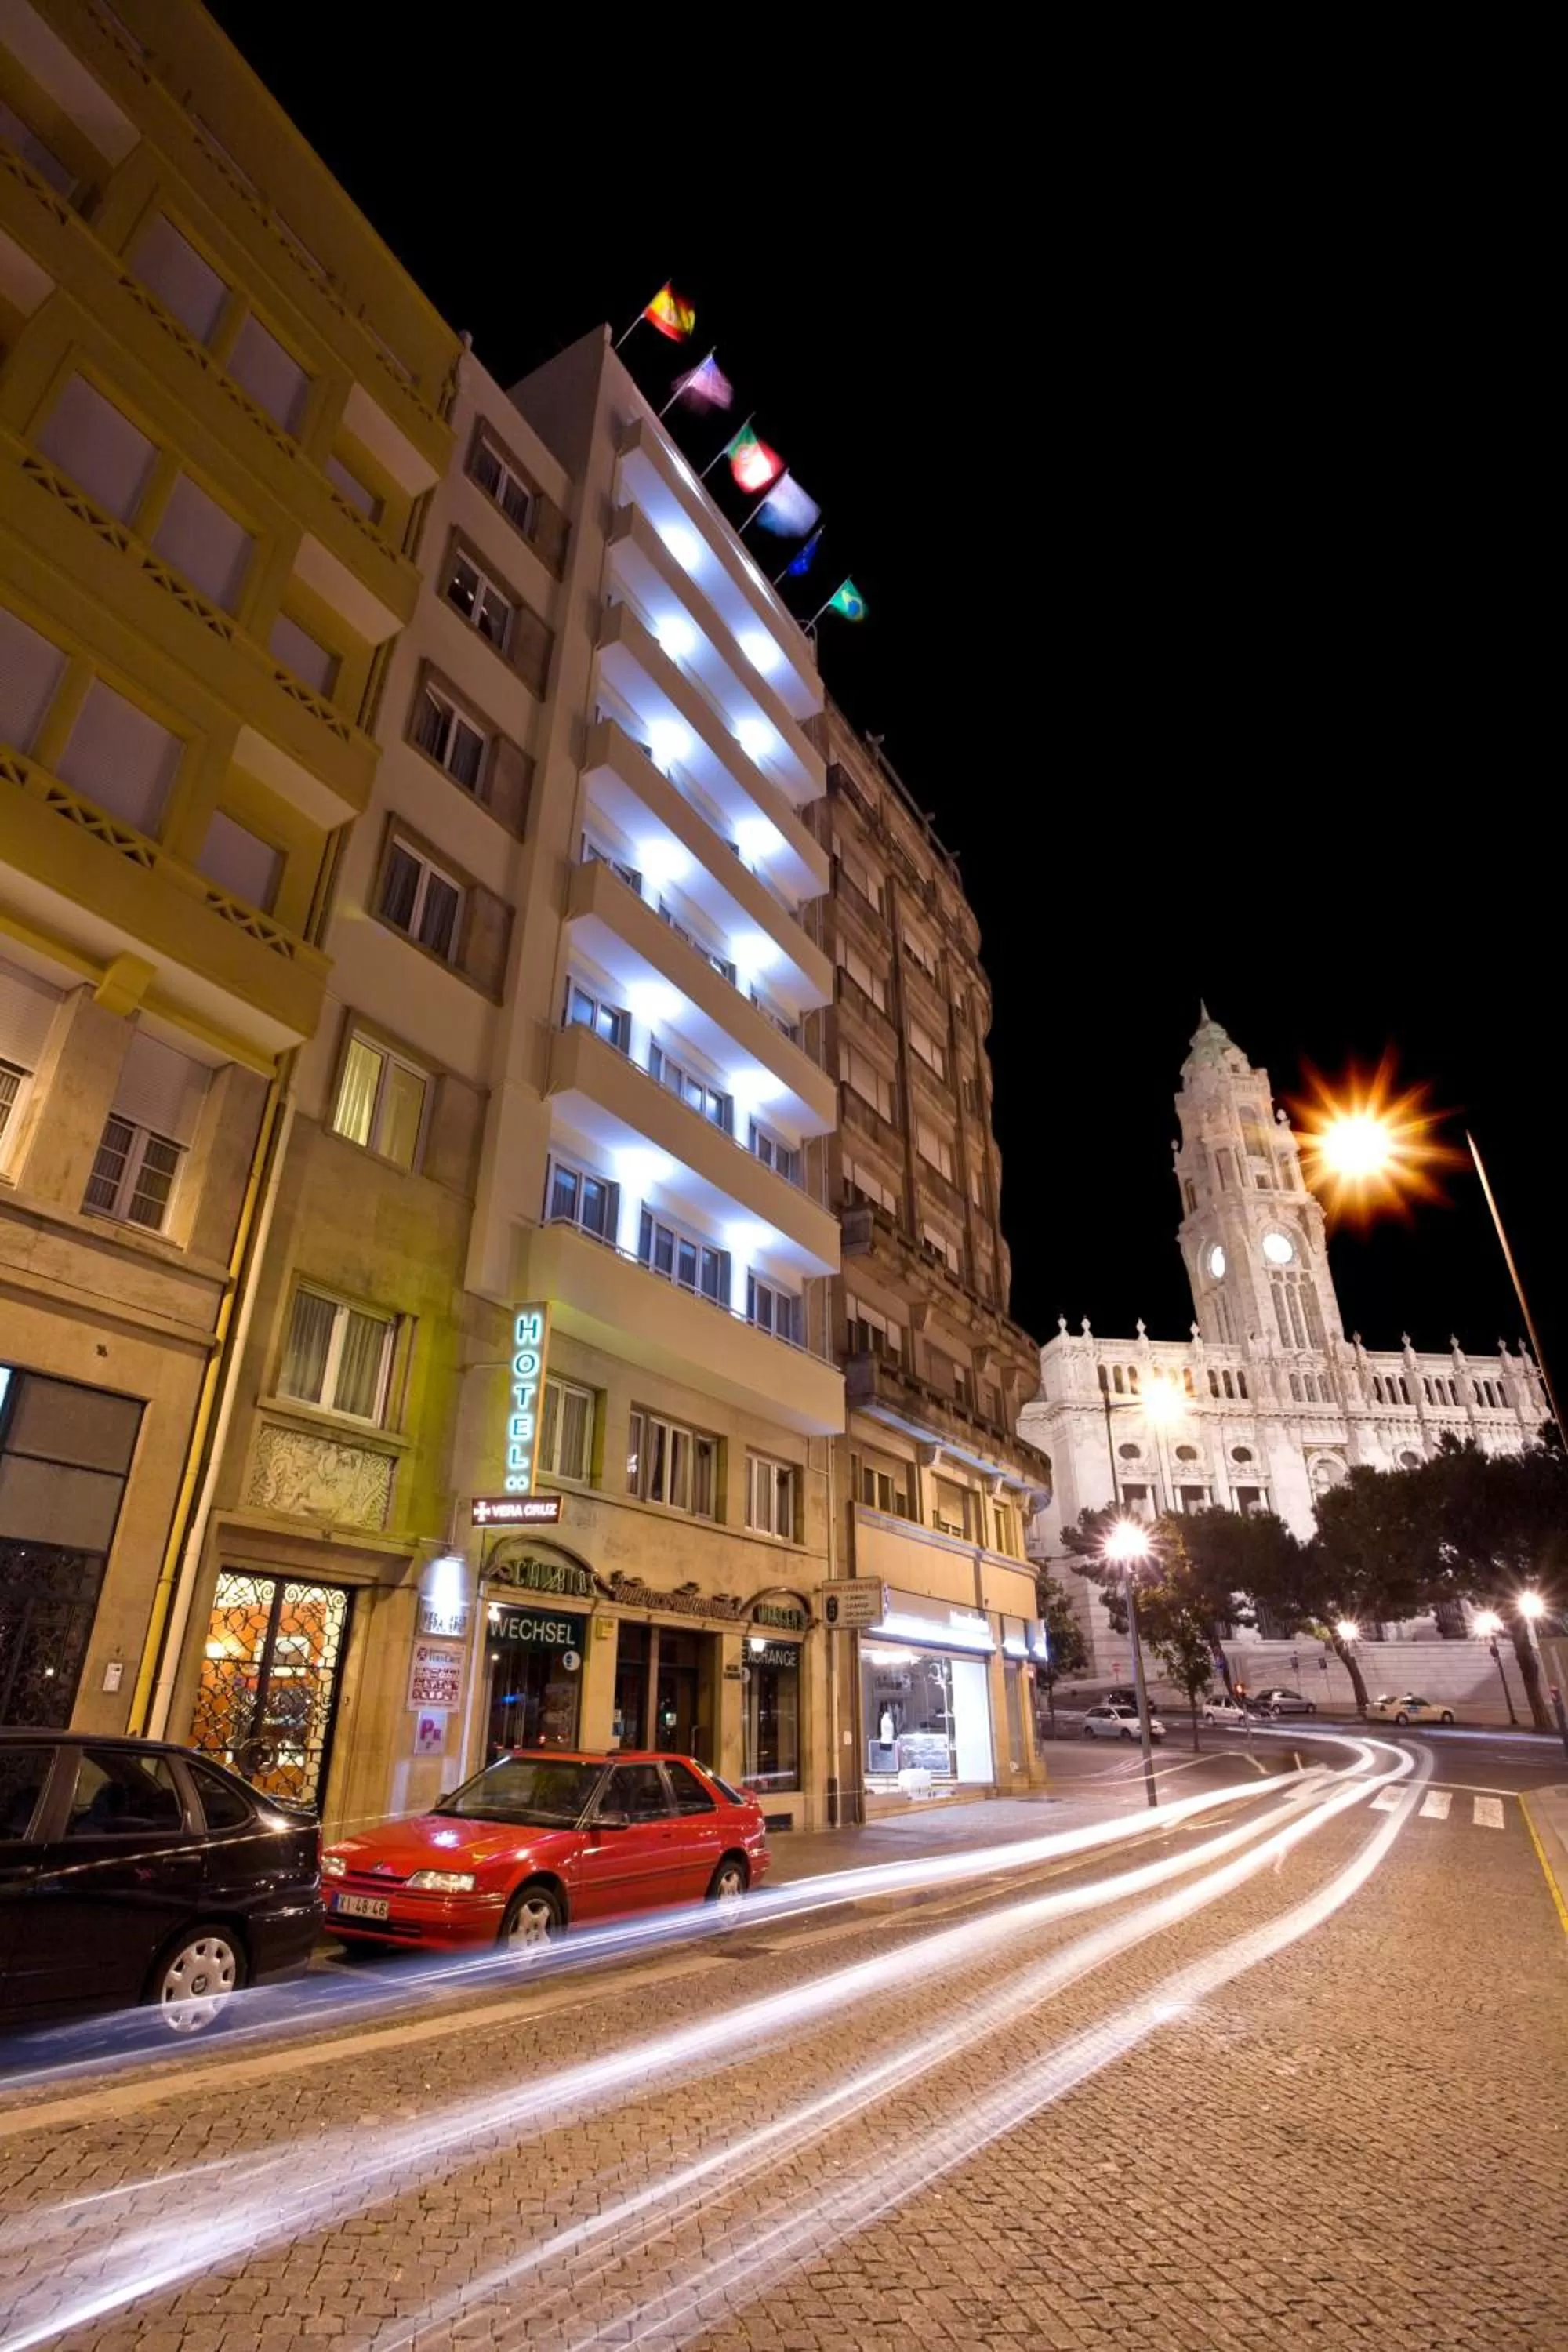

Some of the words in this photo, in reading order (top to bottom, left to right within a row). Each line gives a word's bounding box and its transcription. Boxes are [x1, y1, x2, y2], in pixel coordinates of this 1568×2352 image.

[510, 1315, 542, 1469] HOTEL
[492, 1504, 523, 1517] VERA
[524, 1503, 557, 1516] CRUZ
[489, 1617, 576, 1646] WECHSEL
[742, 1646, 797, 1668] EXCHANGE
